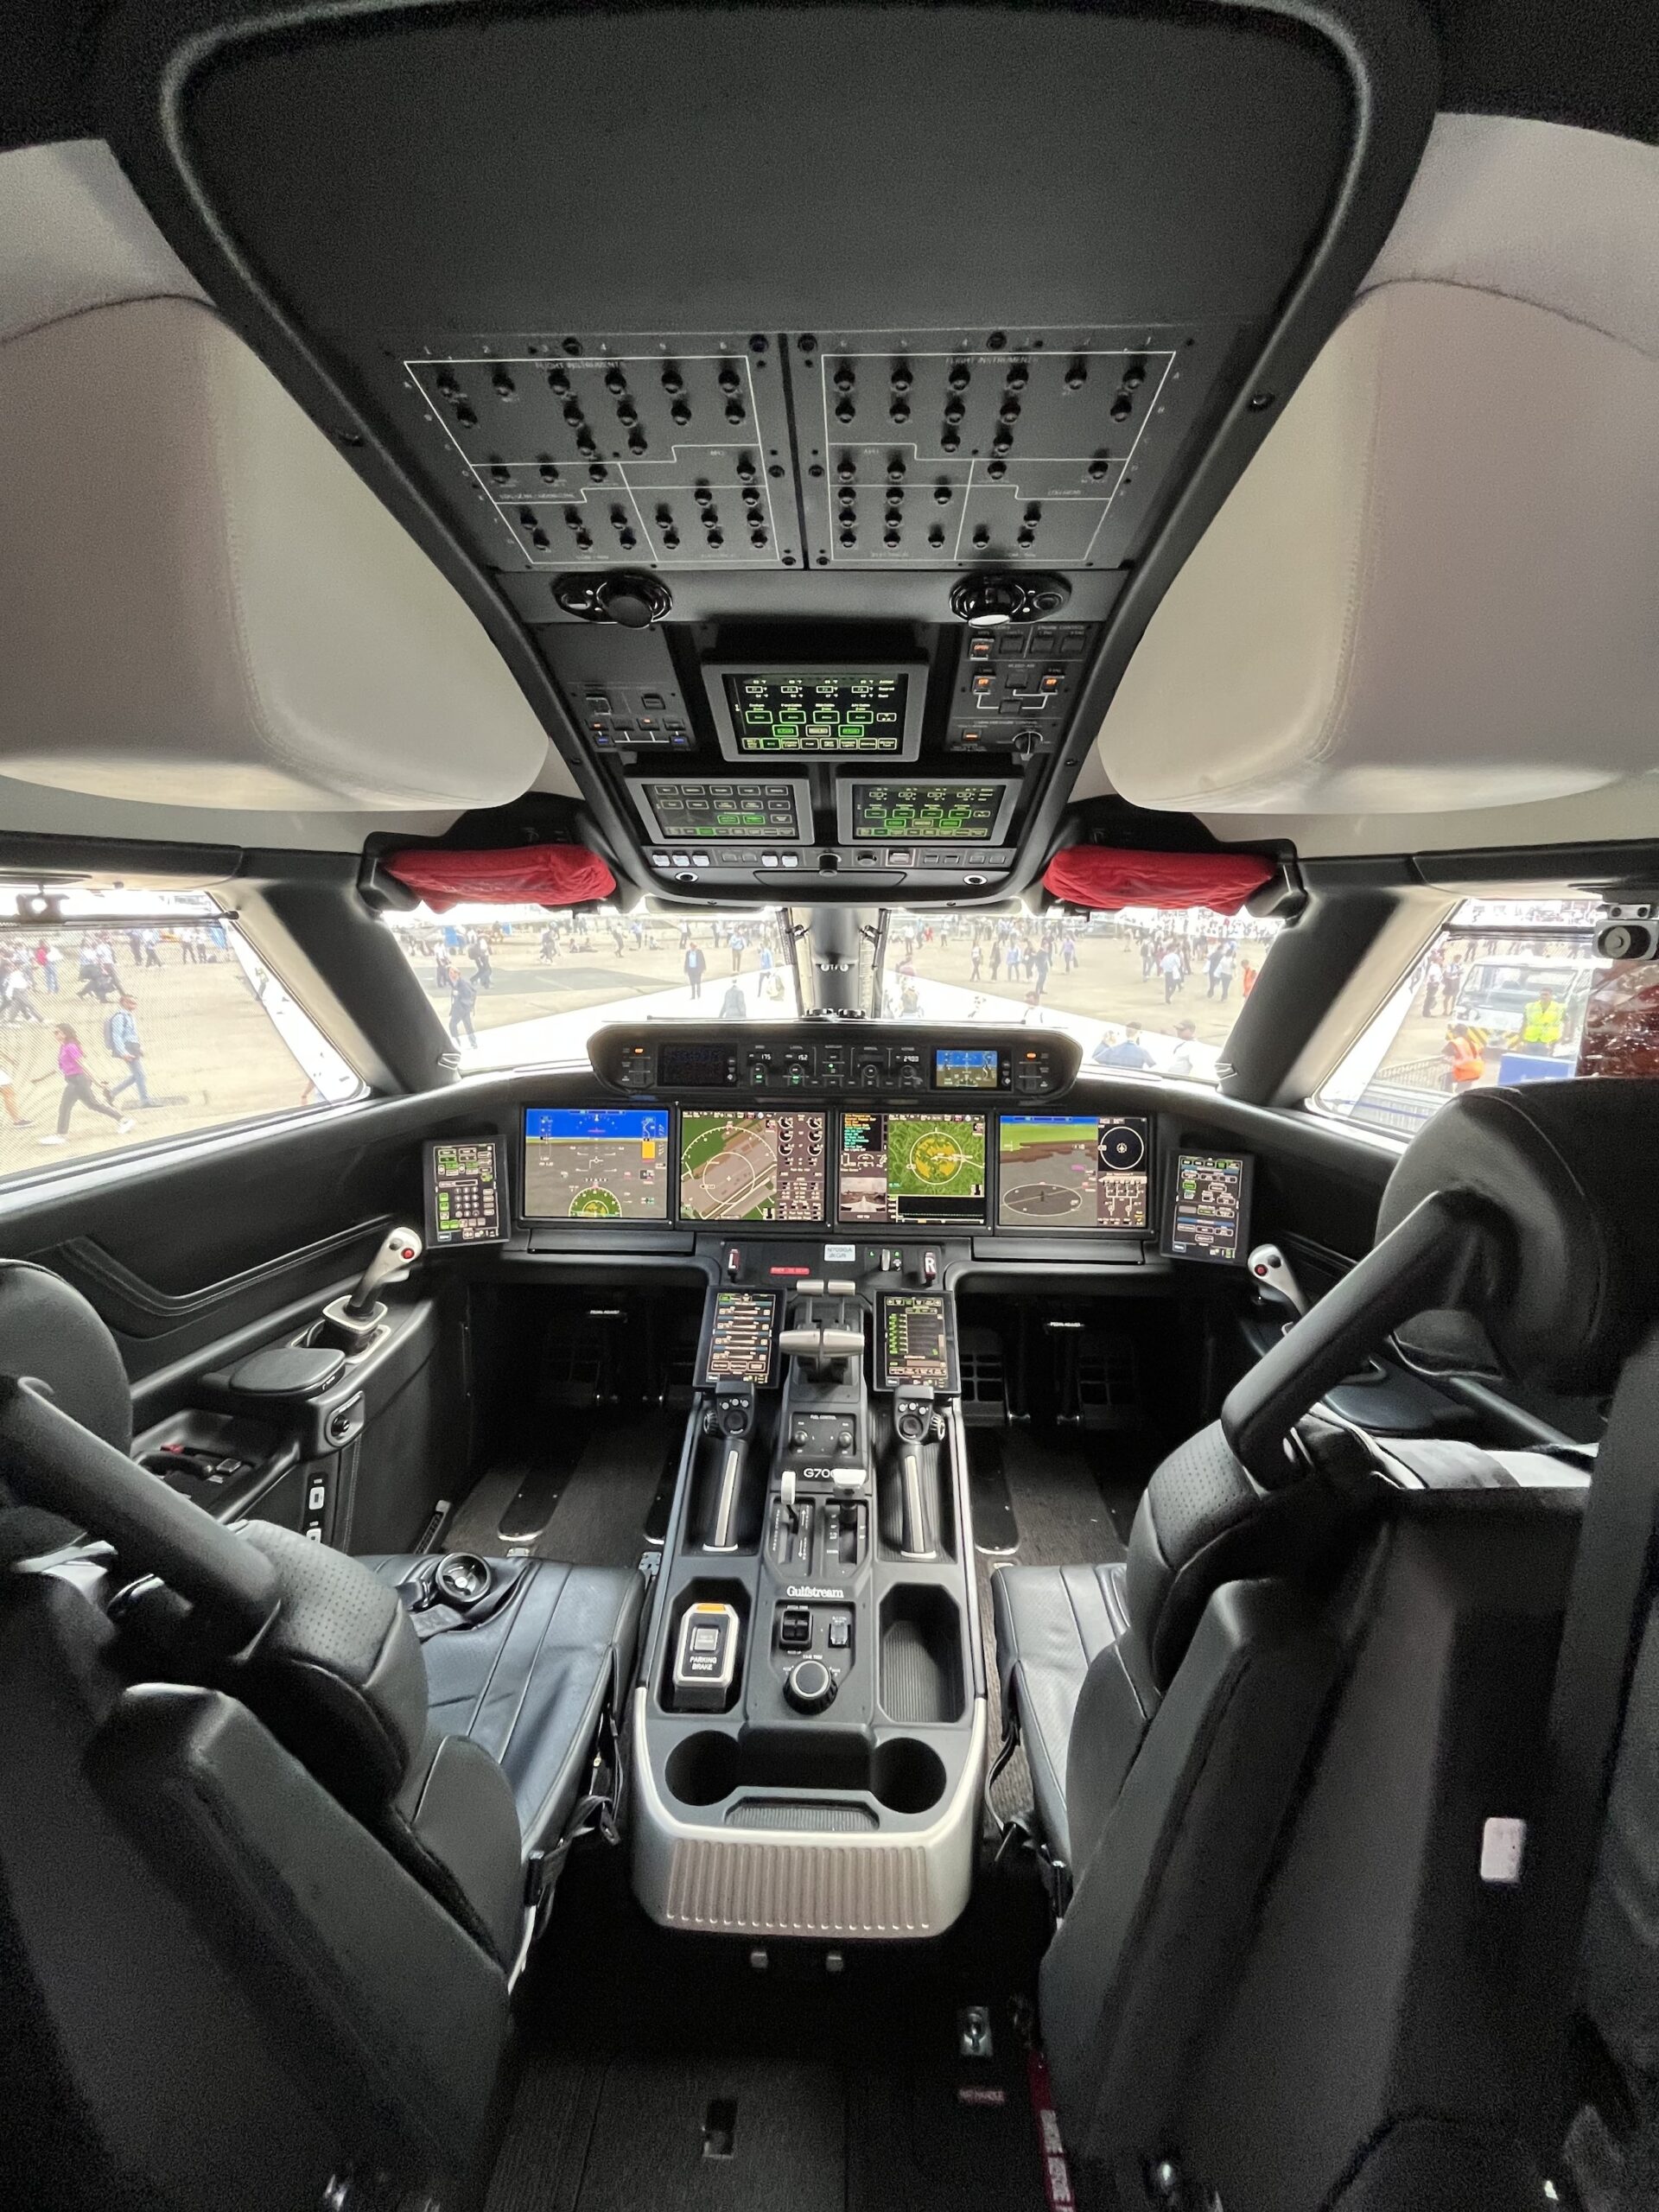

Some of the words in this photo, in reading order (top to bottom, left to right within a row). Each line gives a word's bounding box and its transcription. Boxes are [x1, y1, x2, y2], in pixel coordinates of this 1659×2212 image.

[728, 1253, 736, 1269] L
[925, 1256, 936, 1273] R
[804, 1467, 834, 1478] G70
[786, 1586, 844, 1598] Gulfstream
[690, 1656, 717, 1664] PARKING
